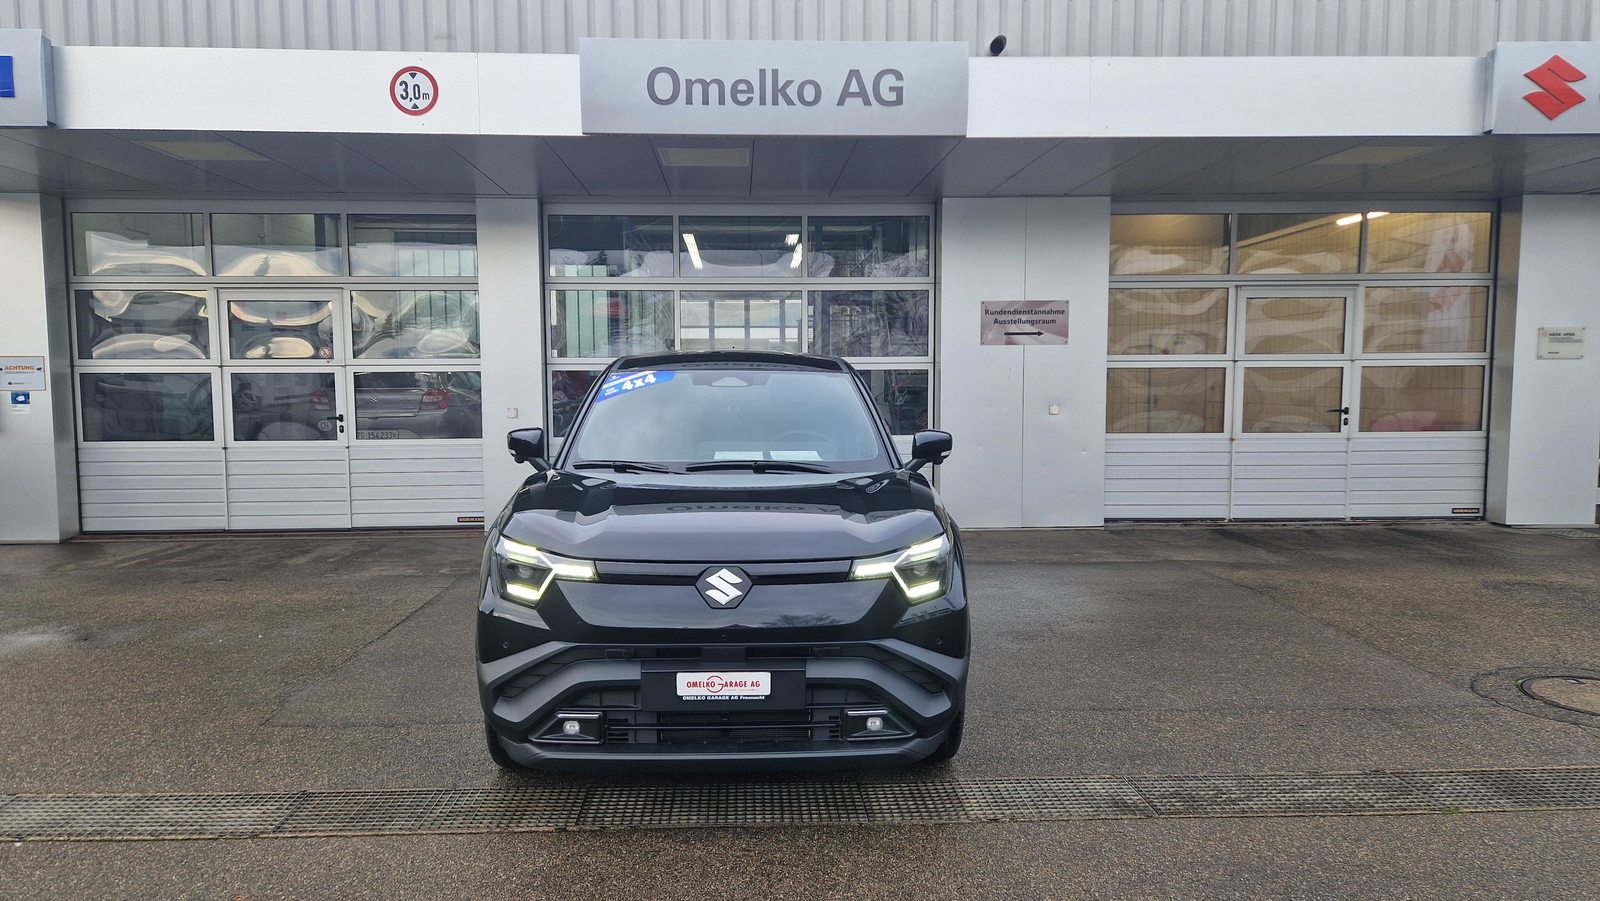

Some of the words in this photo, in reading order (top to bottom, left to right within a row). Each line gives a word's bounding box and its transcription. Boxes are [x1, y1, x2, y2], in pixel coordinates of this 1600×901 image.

[646, 66, 822, 107] Omelko
[836, 68, 904, 107] AG
[984, 308, 1066, 316] Kundendienstannahme
[993, 318, 1057, 326] Ausstellungsraum
[622, 373, 657, 391] 4x4
